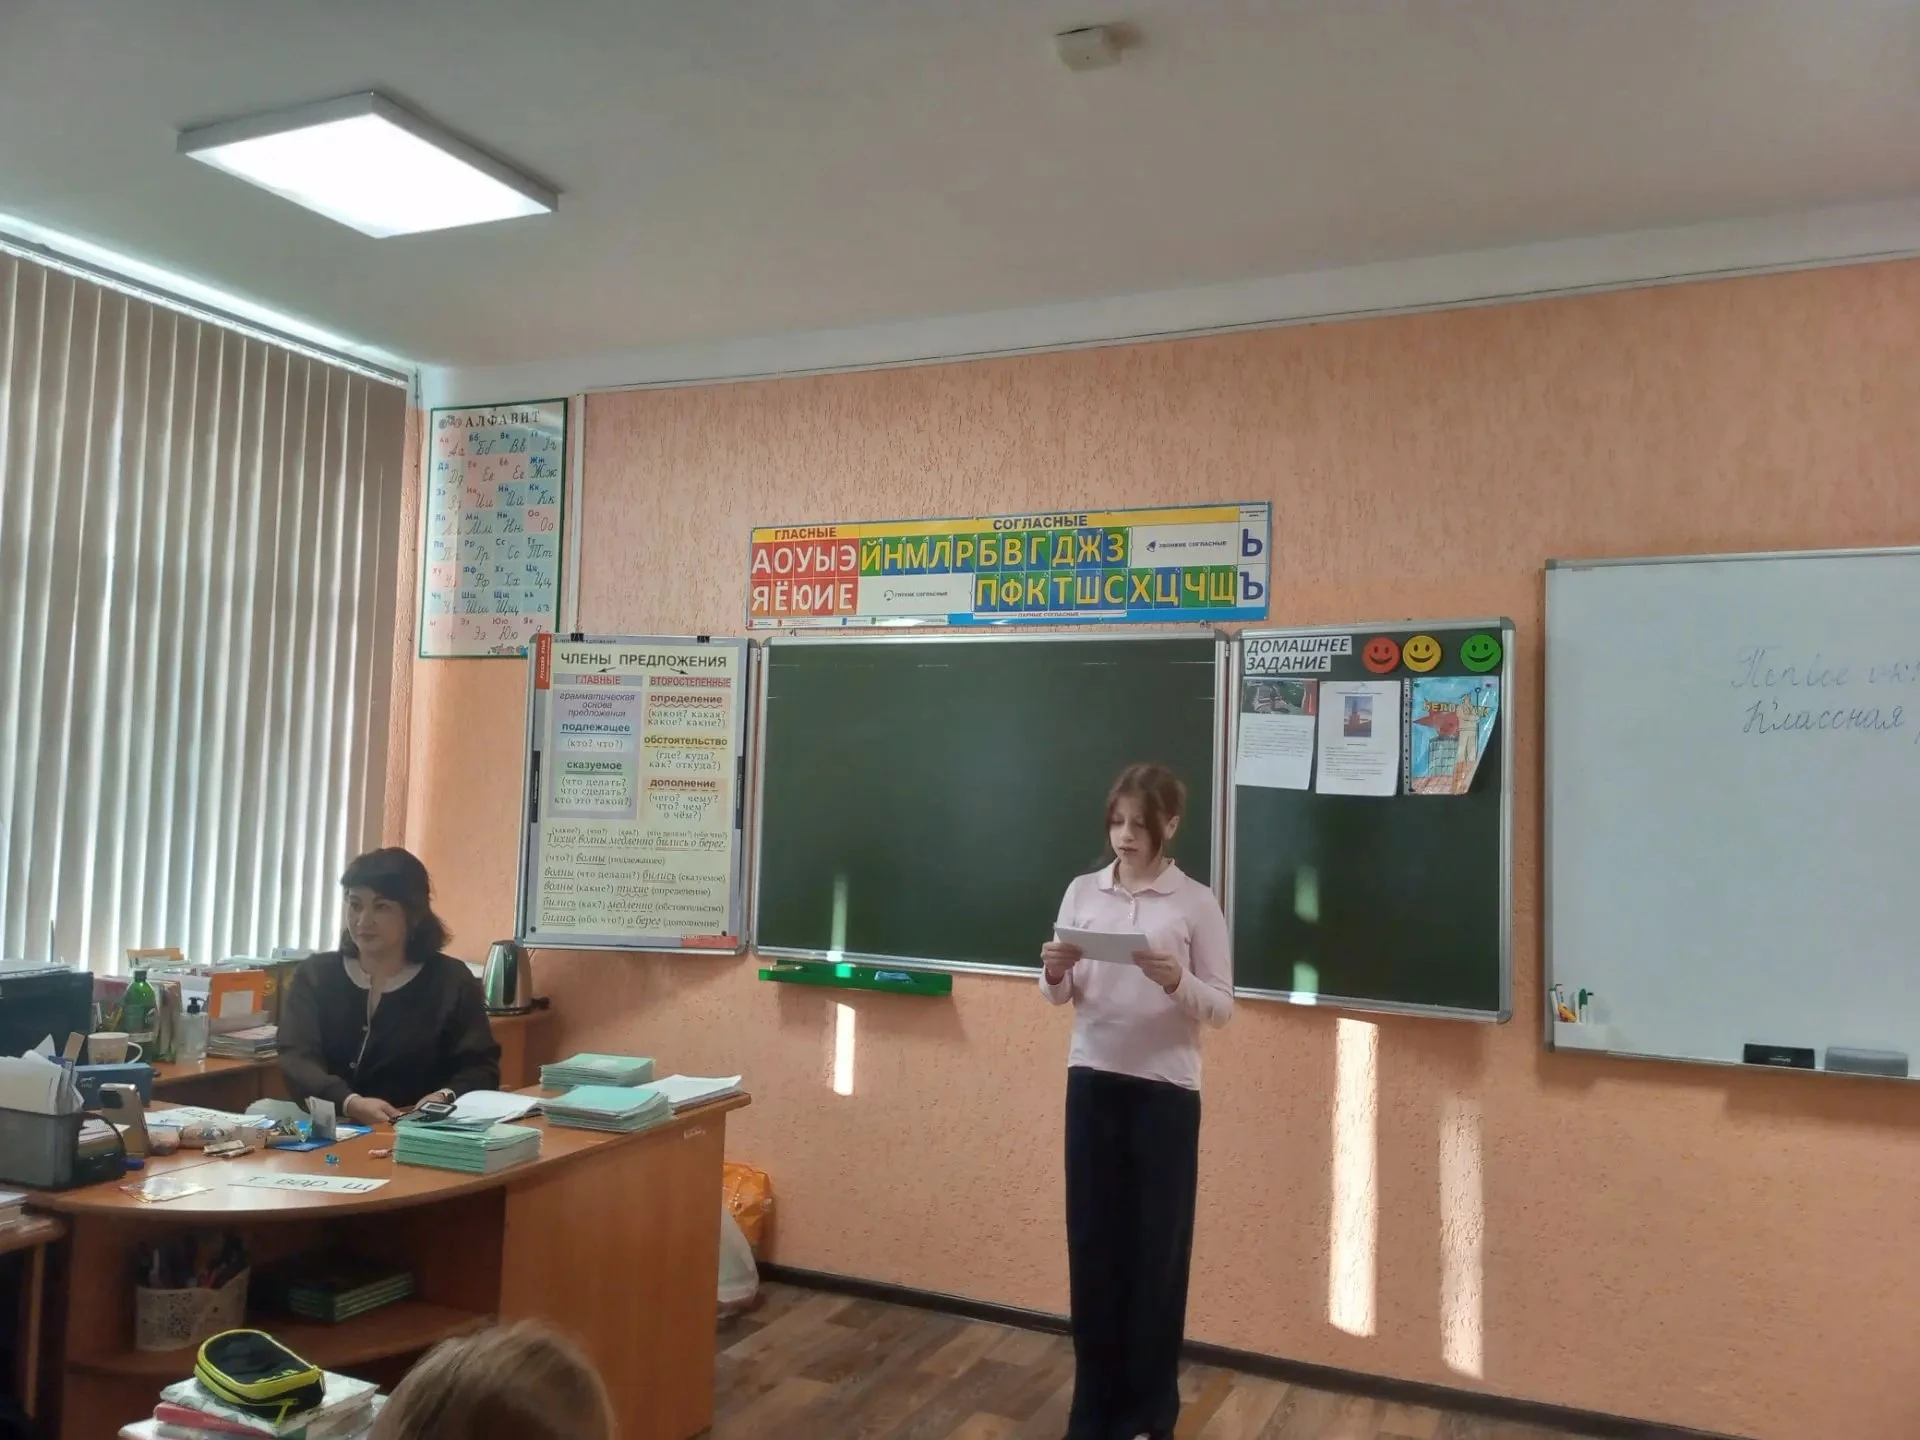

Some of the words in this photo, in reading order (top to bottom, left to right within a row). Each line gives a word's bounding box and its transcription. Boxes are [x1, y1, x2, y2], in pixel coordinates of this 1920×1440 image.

[465, 410, 540, 428] АЛФАВИТ
[993, 515, 1088, 530] СОГЛАСНЫЕ
[775, 527, 837, 540] ГЛАСНЫЕ
[1242, 529, 1263, 556] Ь
[1240, 572, 1263, 600] Ъ
[1247, 638, 1350, 654] ДОМАШНЕЕ
[561, 653, 611, 664] ЧЛЕНЫ
[619, 654, 727, 667] ПРЕДЛОЖЕНИЯ
[1246, 656, 1328, 673] ЗАДАНИЕ
[576, 675, 621, 685] ГЛАВНЫЕ
[651, 677, 731, 688] ВТОРОСТЕПЕННЫЕ
[560, 693, 635, 701] грамматическая
[651, 695, 722, 704] определение
[568, 709, 625, 718] предложения
[562, 723, 630, 733] подлежащее
[567, 739, 593, 748] (кто?
[597, 739, 623, 749] что?)
[644, 736, 727, 746] обстоятельство
[656, 751, 681, 761] (где?
[685, 751, 715, 761] куда?
[567, 761, 622, 771] сказуемое
[649, 760, 672, 768] как?
[676, 761, 721, 771] откуда?)
[562, 778, 582, 787] (что
[586, 778, 626, 787] делать?
[650, 779, 716, 788] дополнение
[582, 787, 627, 796] сделать?
[547, 832, 576, 844] Тихие
[578, 834, 606, 844] волны
[656, 836, 688, 847] бились
[545, 853, 573, 862] (что?)
[576, 853, 606, 863] волны
[544, 867, 574, 877] волны
[576, 871, 596, 879] (что
[643, 871, 676, 881] бились
[544, 882, 573, 891] волны
[576, 884, 614, 893] (какие?)
[616, 885, 649, 894] тихие
[543, 897, 576, 907] бились
[607, 900, 653, 910] медленно
[543, 913, 576, 922] бились
[636, 916, 661, 927] берег
